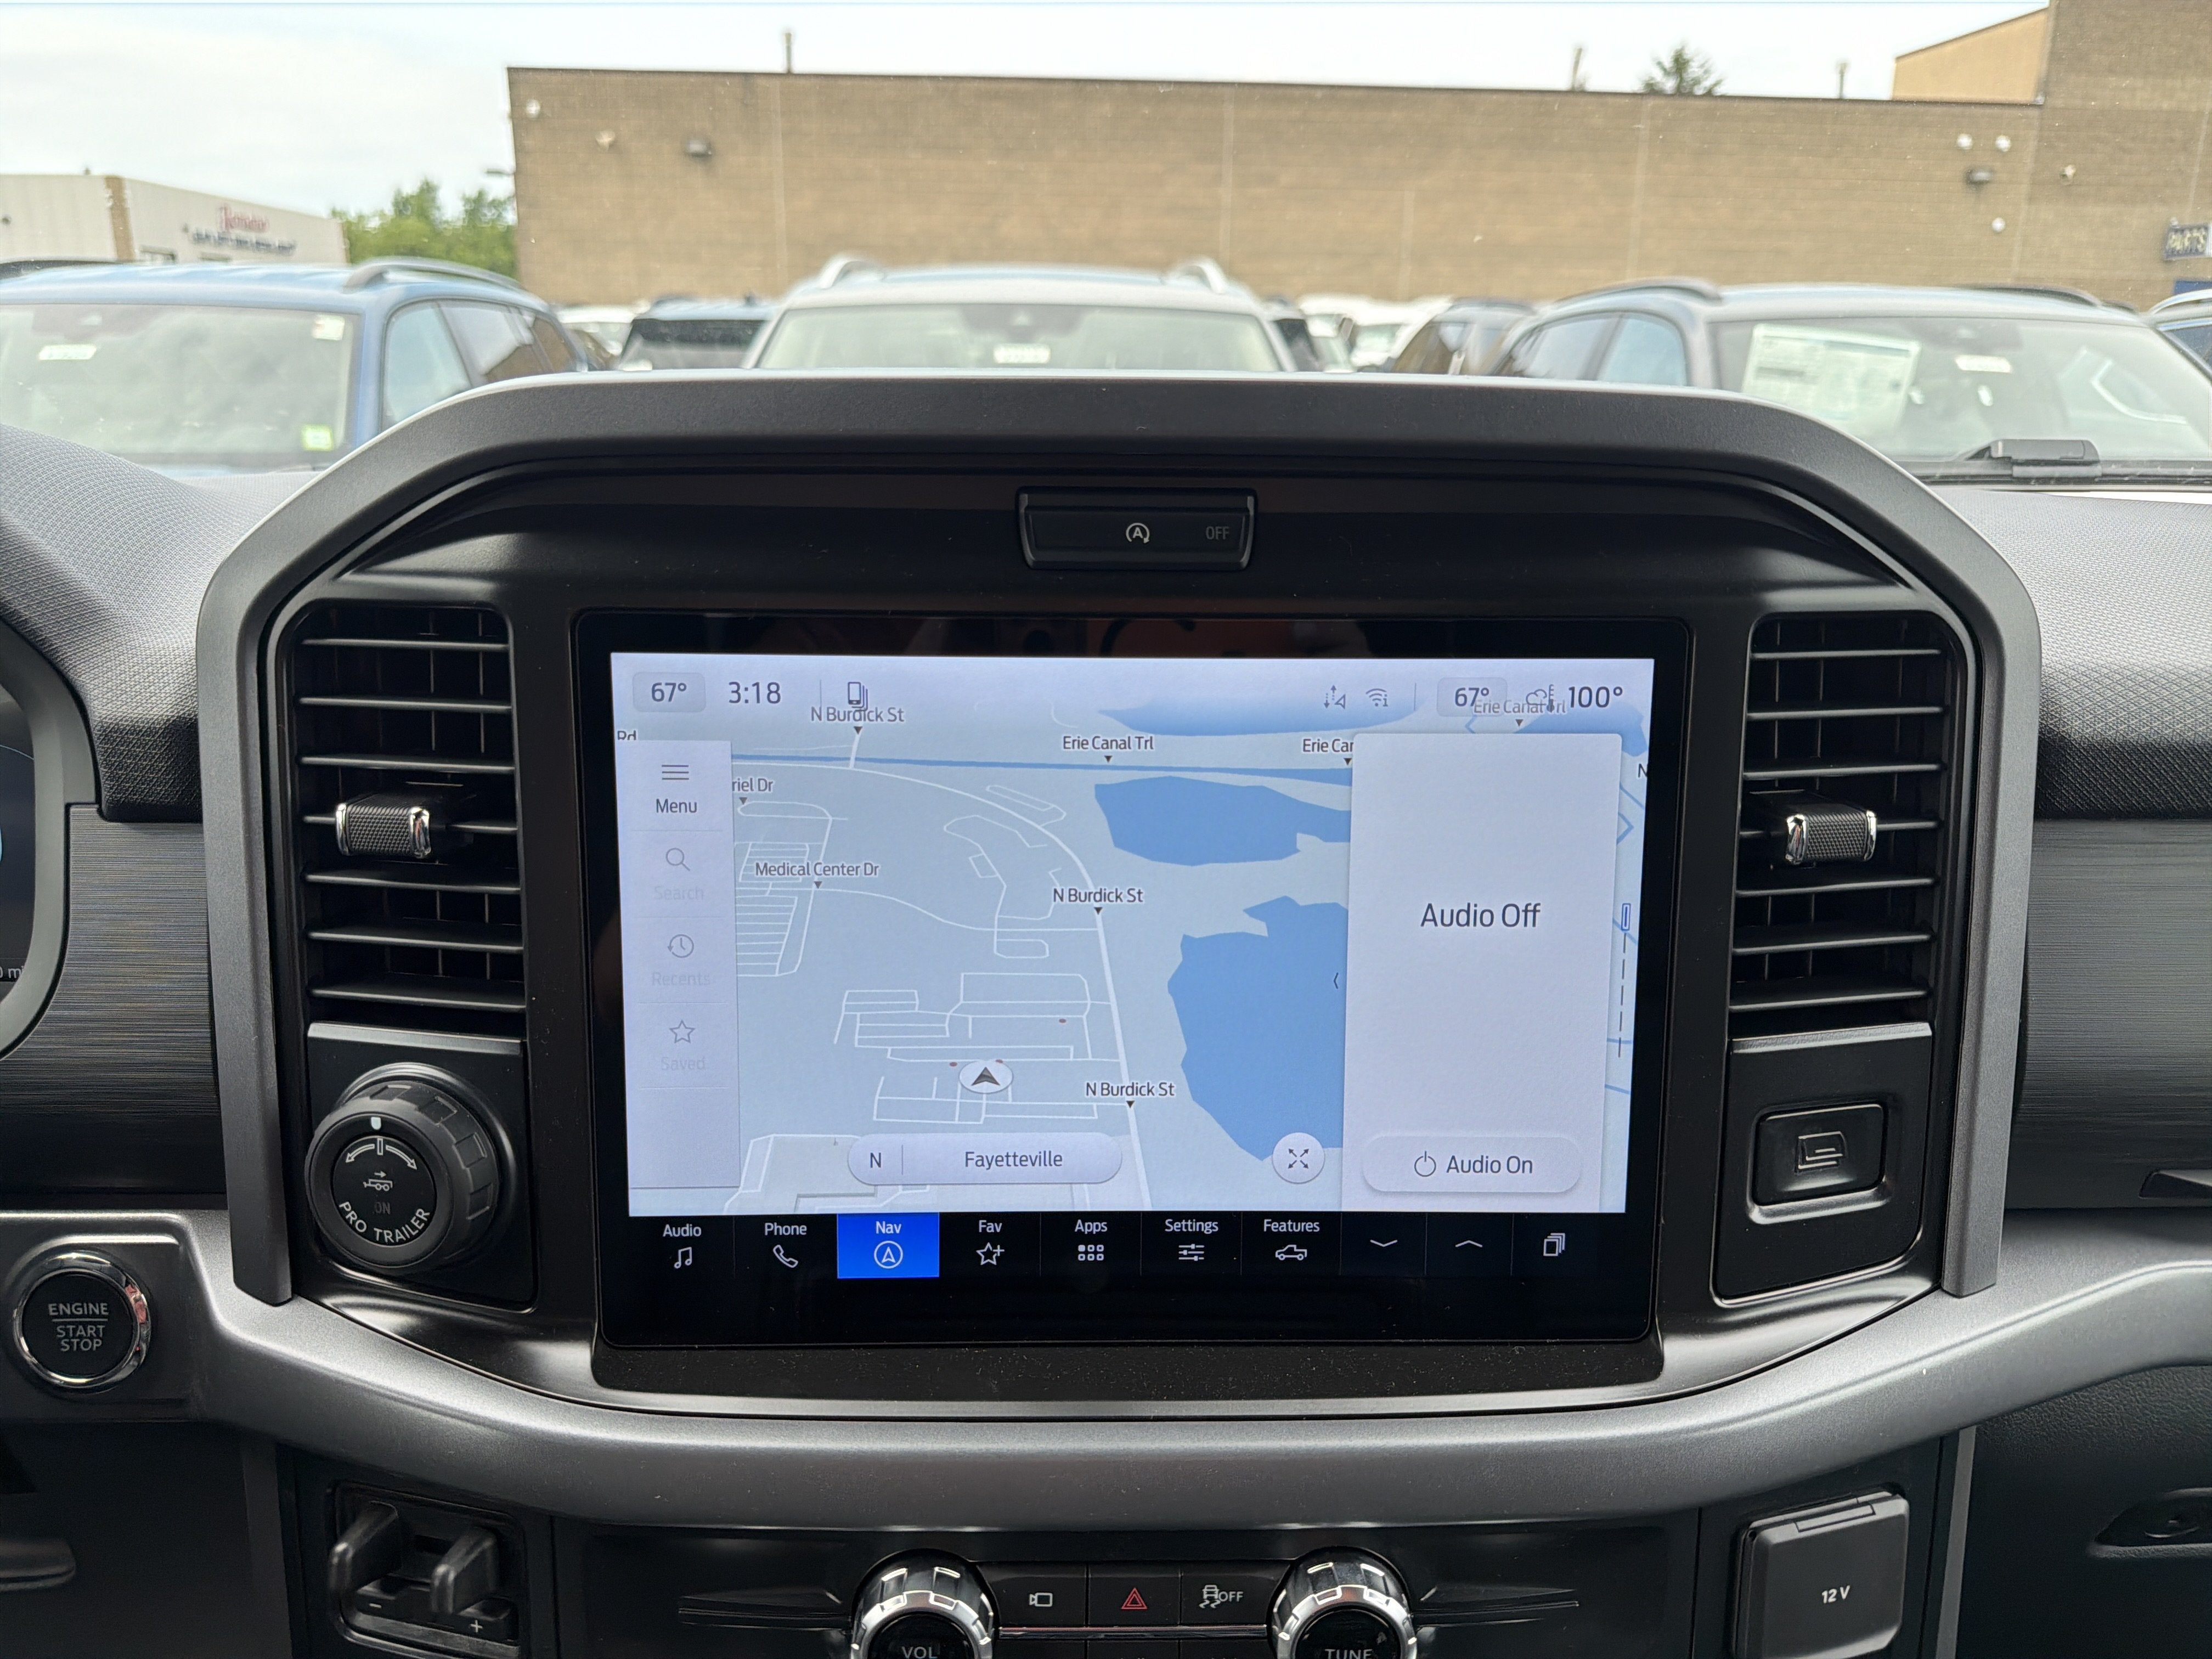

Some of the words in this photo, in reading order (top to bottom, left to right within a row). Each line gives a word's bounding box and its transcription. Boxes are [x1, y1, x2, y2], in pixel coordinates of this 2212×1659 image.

[1205, 526, 1230, 540] OFF
[729, 681, 781, 704] 3:18
[811, 706, 822, 721] N
[887, 707, 905, 722] St
[1063, 736, 1089, 750] Erie
[1092, 736, 1132, 750] Canal
[1135, 736, 1154, 750] Trl
[1302, 738, 1329, 753] Erie
[758, 778, 774, 792] Dr
[656, 798, 698, 813] Menu
[755, 862, 811, 876] Medical
[814, 862, 861, 876] Center
[864, 862, 880, 876] Dr
[654, 885, 704, 900] Search
[1053, 888, 1064, 902] N
[1068, 888, 1123, 902] Burdick
[1127, 888, 1144, 903] St
[1420, 902, 1494, 927] Audio
[1502, 902, 1542, 928] Off
[652, 971, 710, 986] Recents
[661, 1056, 706, 1070] Saved
[1086, 1082, 1097, 1097] N
[1101, 1082, 1154, 1097] Burdick
[1158, 1082, 1175, 1097] St
[870, 1152, 882, 1169] N
[965, 1150, 1063, 1171] Fayetteville
[1446, 1155, 1501, 1174] Audio
[1506, 1155, 1533, 1174] On
[338, 1201, 367, 1233] PRO
[374, 1208, 431, 1243] TRAILER
[764, 1222, 807, 1236] Phone
[875, 1221, 902, 1234] Nav
[979, 1220, 1002, 1233] Fav
[1074, 1219, 1108, 1234] Apps
[1165, 1218, 1219, 1234] Settings
[1263, 1218, 1321, 1232] Features
[663, 1223, 702, 1237] Audio
[48, 1302, 109, 1316] ENGINE
[56, 1325, 105, 1338] START
[60, 1339, 103, 1352] STOP
[1218, 1591, 1244, 1602] OFF
[901, 1646, 938, 1659] VOL
[1324, 1649, 1373, 1659] TUNE
